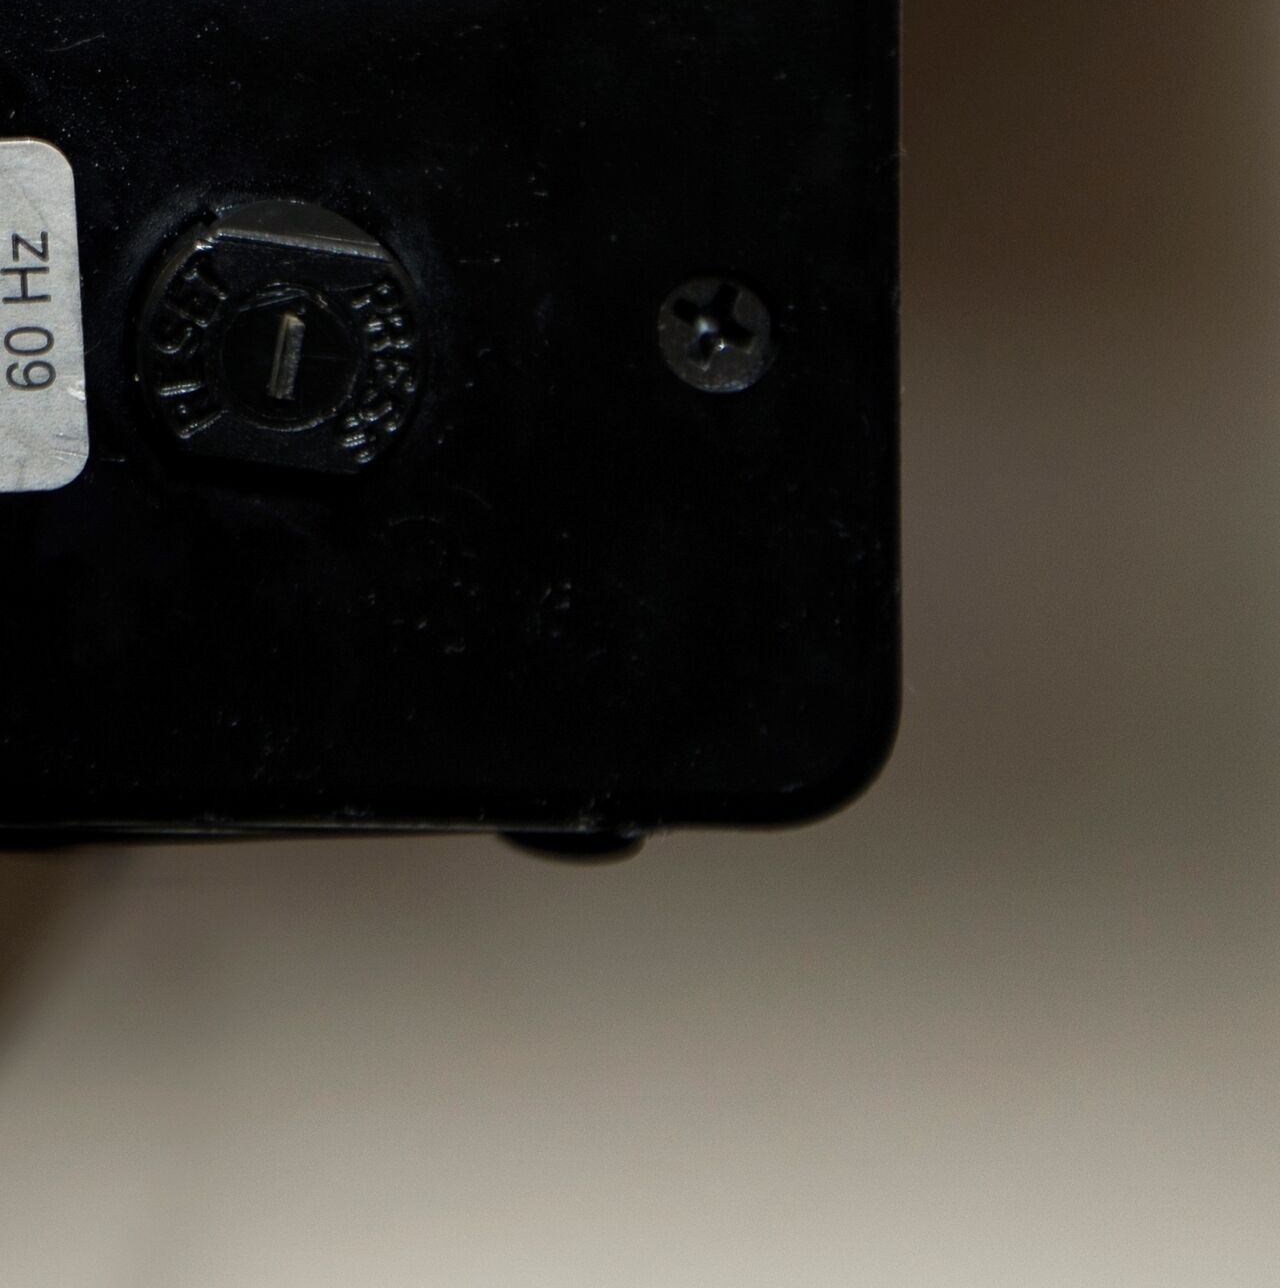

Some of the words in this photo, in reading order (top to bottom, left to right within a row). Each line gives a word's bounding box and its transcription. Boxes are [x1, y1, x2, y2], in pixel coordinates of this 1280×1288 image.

[0, 231, 51, 304] Hz
[3, 326, 56, 391] 60
[151, 260, 229, 441] RESET
